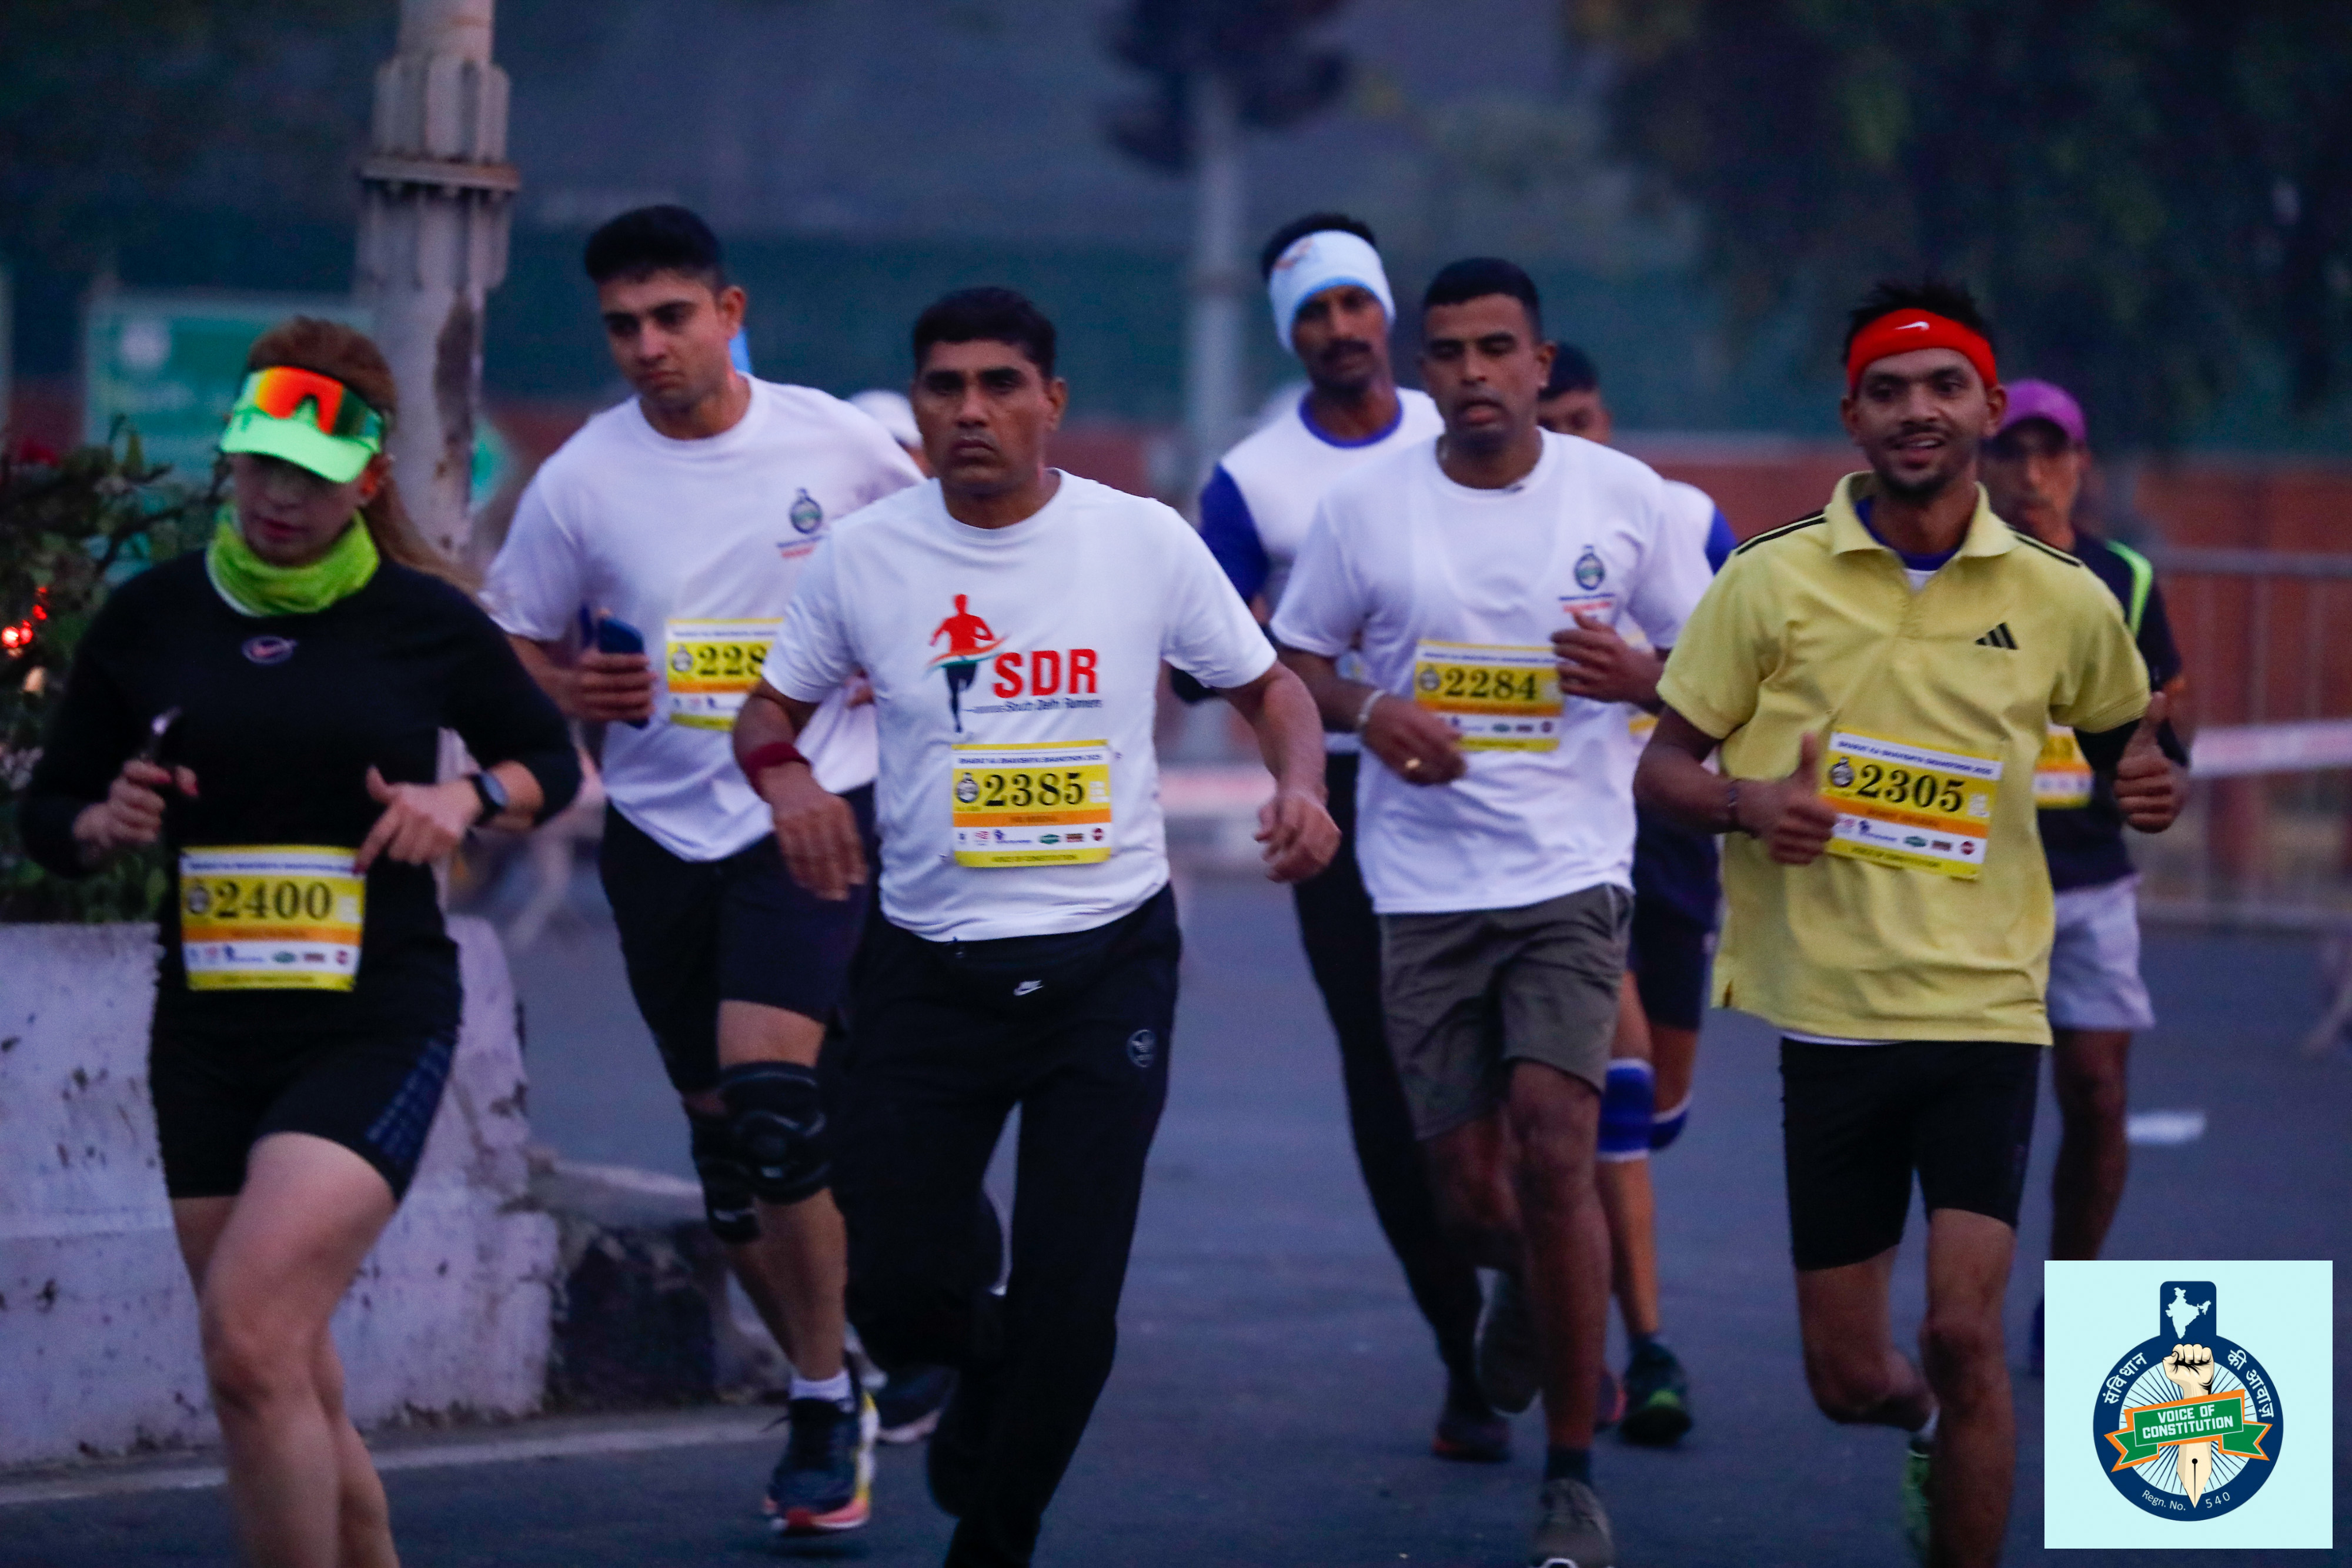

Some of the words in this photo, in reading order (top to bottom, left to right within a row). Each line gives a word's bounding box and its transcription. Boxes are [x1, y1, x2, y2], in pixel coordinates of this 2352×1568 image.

[697, 645, 767, 676] 228
[993, 648, 1098, 698] SDR
[1445, 667, 1536, 700] 2284
[984, 773, 1084, 806] 2385
[1856, 764, 1966, 812] 2305
[215, 881, 333, 920] 2400
